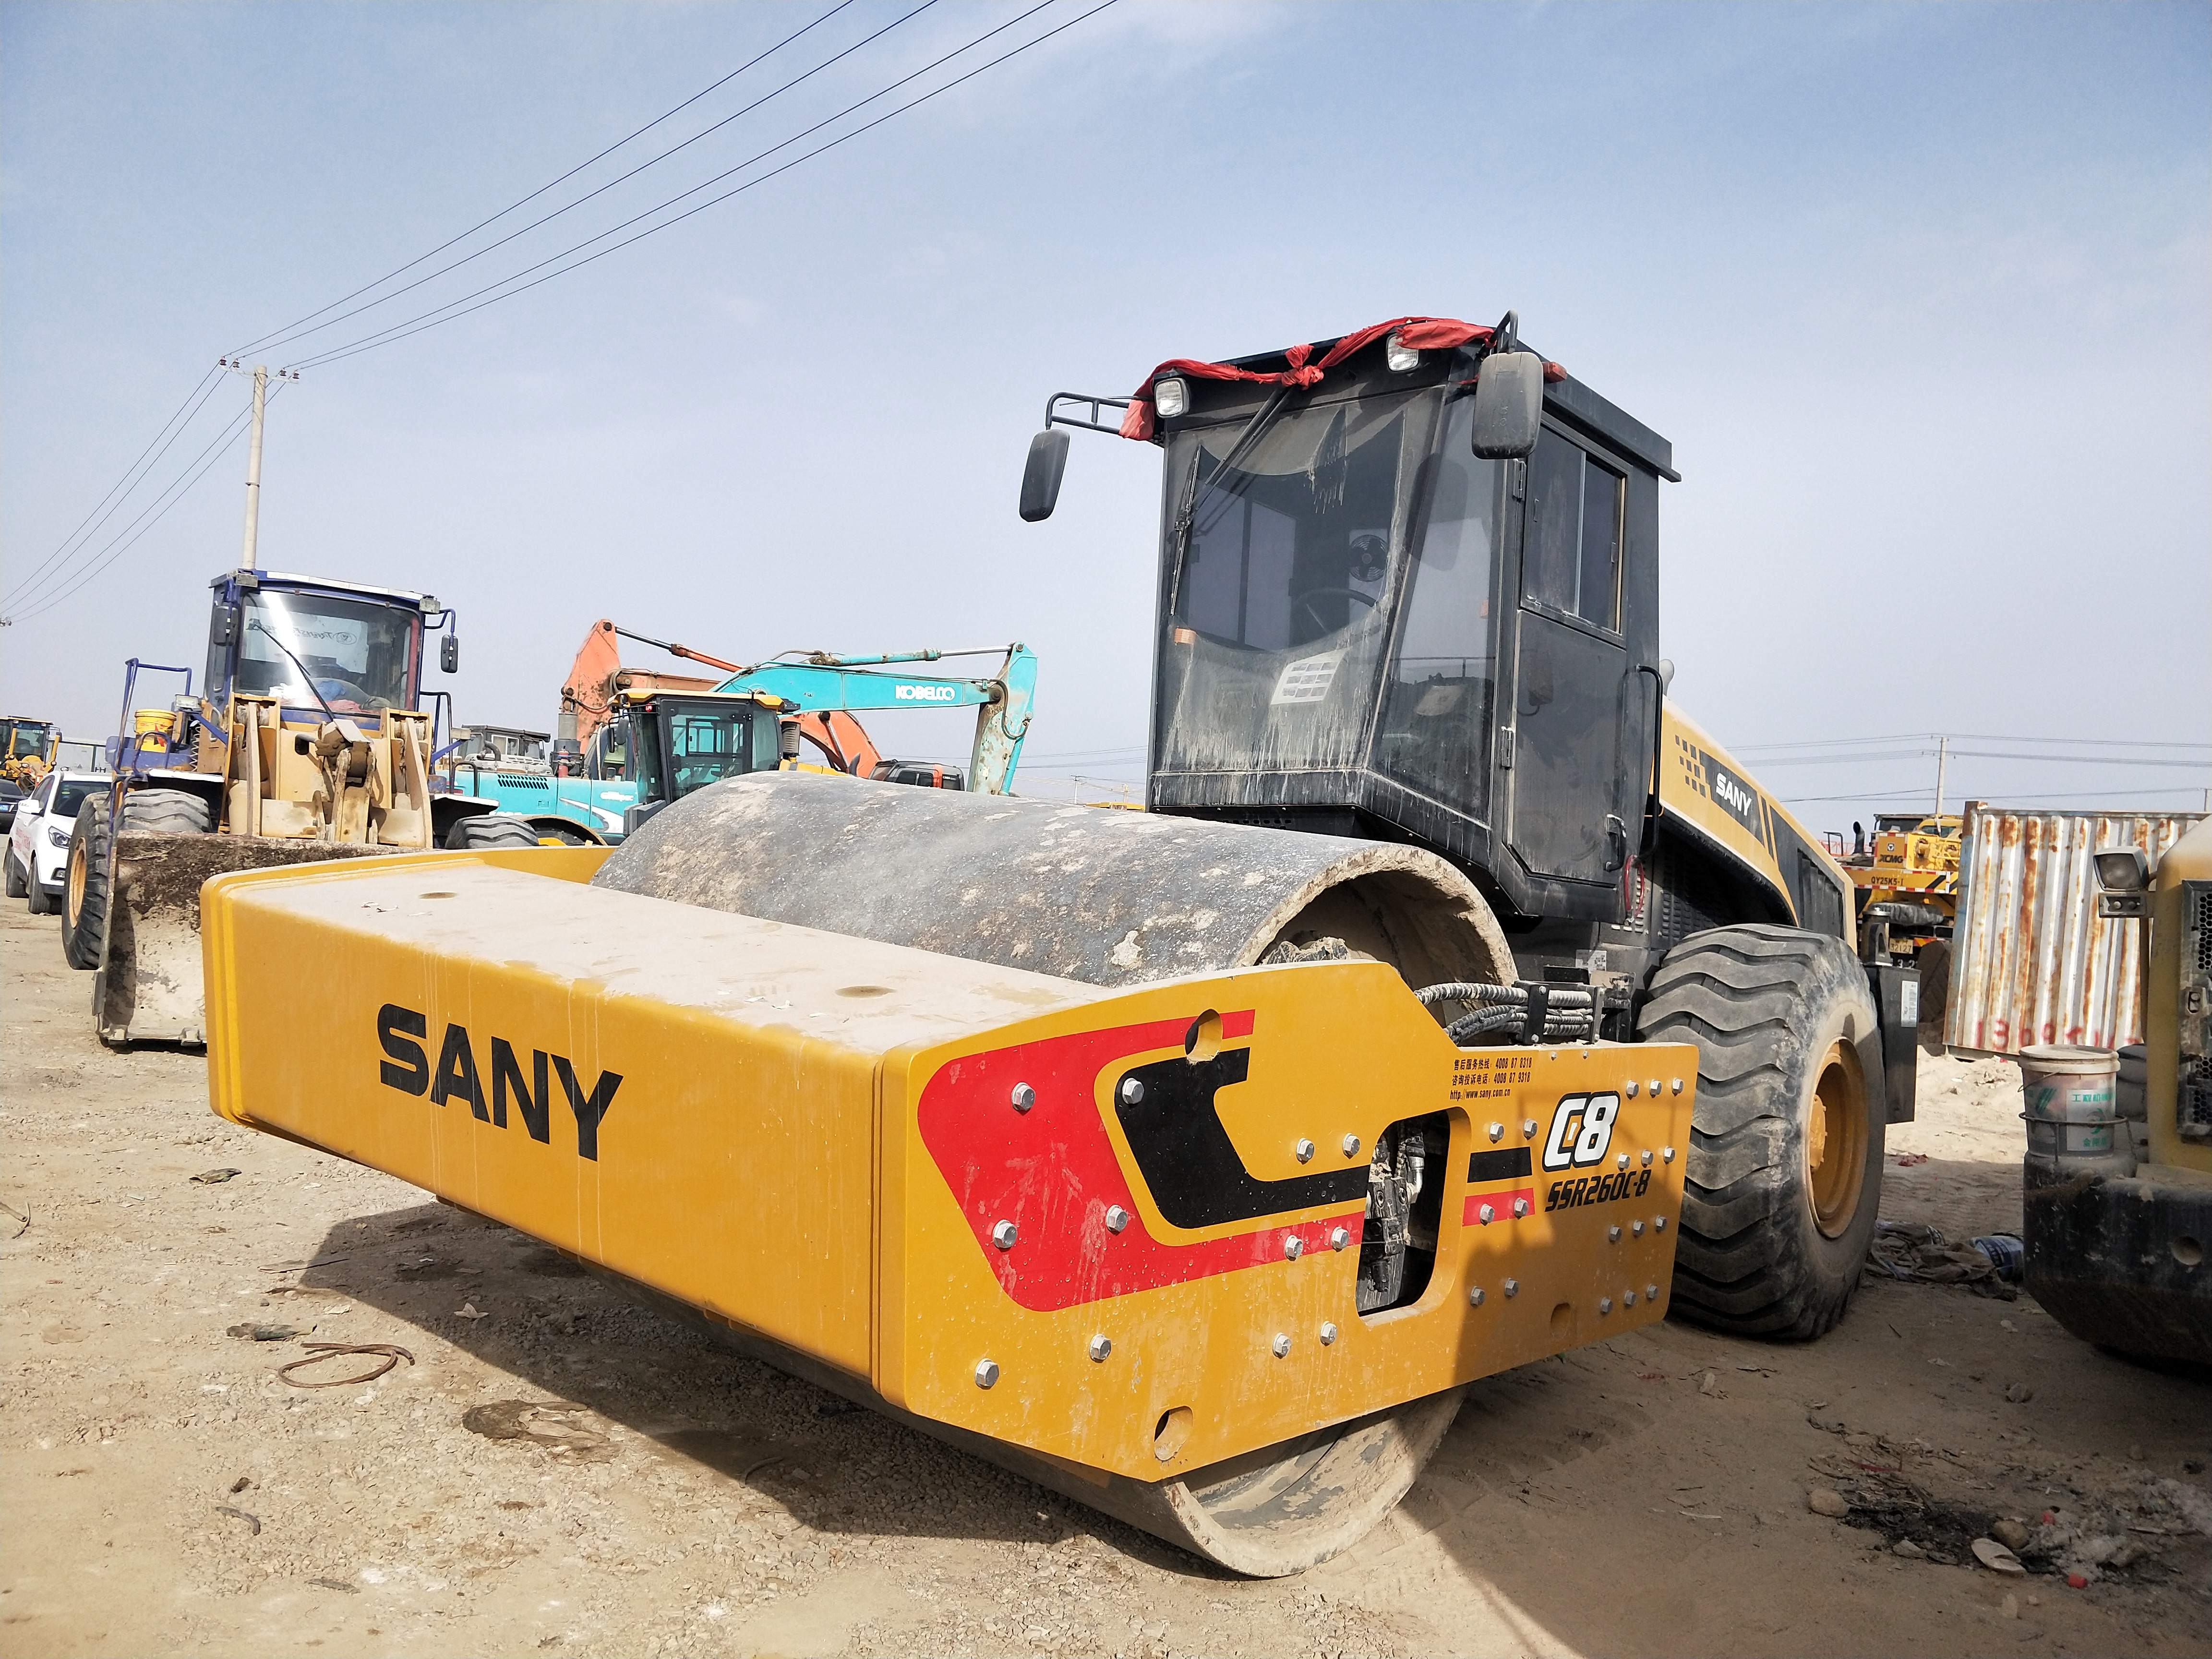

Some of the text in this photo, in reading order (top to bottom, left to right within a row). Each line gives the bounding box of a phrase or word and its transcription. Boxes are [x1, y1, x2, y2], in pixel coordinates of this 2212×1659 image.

[895, 685, 955, 701] KOBELCO
[1716, 772, 1752, 817] SANY
[1879, 854, 1904, 863] XCMG
[1495, 1058, 1508, 1069] 4008
[1511, 1058, 1517, 1068] 87
[1520, 1057, 1532, 1068] 8318
[377, 1003, 624, 1162] SANY
[1494, 1072, 1507, 1083] 4008
[1509, 1072, 1515, 1083] 87
[1518, 1071, 1530, 1083] 9318
[1450, 1089, 1511, 1101] http://www.sany.com.cn
[1542, 1090, 1621, 1172] C8
[1544, 1169, 1651, 1212] SSR260C-8
